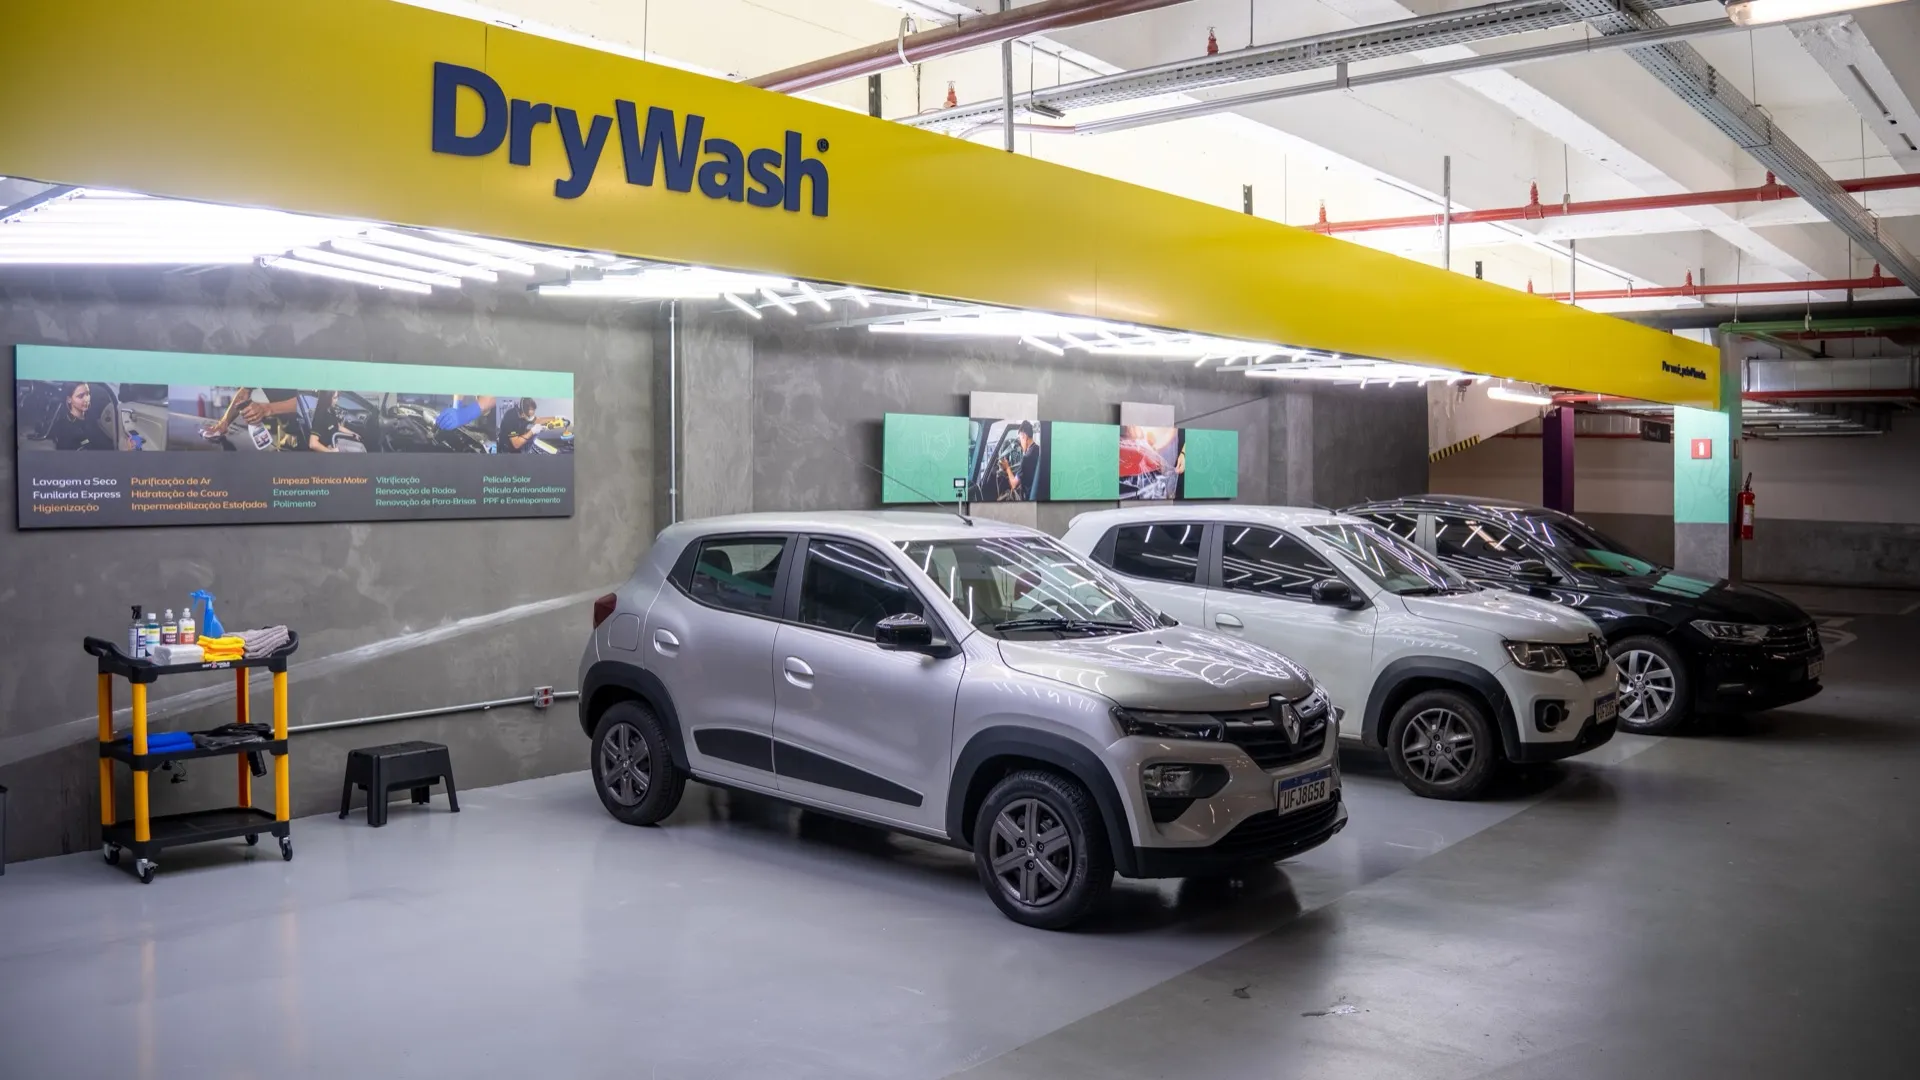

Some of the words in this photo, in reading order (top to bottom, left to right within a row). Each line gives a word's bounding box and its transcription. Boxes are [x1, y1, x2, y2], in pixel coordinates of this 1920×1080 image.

[32, 477, 81, 488] Lavagem
[92, 477, 117, 486] Seco
[130, 476, 185, 487] Purificação
[186, 477, 199, 485] de
[200, 477, 212, 485] Ar
[272, 476, 310, 486] Limpeza
[311, 475, 341, 485] Técnica
[342, 476, 369, 485] Motor
[375, 476, 420, 485] Vitrificação
[512, 475, 532, 483] Solar
[273, 488, 330, 496] Enceramento
[375, 487, 420, 496] Renovação
[512, 485, 566, 493] Antivandalismo
[33, 490, 79, 500] Funilaria
[81, 490, 121, 501] Express
[131, 489, 185, 500] Hidratação
[186, 489, 199, 498] de
[200, 489, 229, 498] Couro
[131, 501, 221, 512] Impermeabilização
[222, 500, 268, 511] Estofados
[273, 499, 317, 508] Polimento
[375, 498, 420, 507] Renovação
[420, 498, 431, 506] de
[431, 497, 477, 505] Para-Brisas
[483, 497, 499, 505] PPF
[506, 497, 561, 506] Envelopamento
[33, 503, 100, 514] Higienização
[1284, 780, 1325, 810] UFJ8G58
